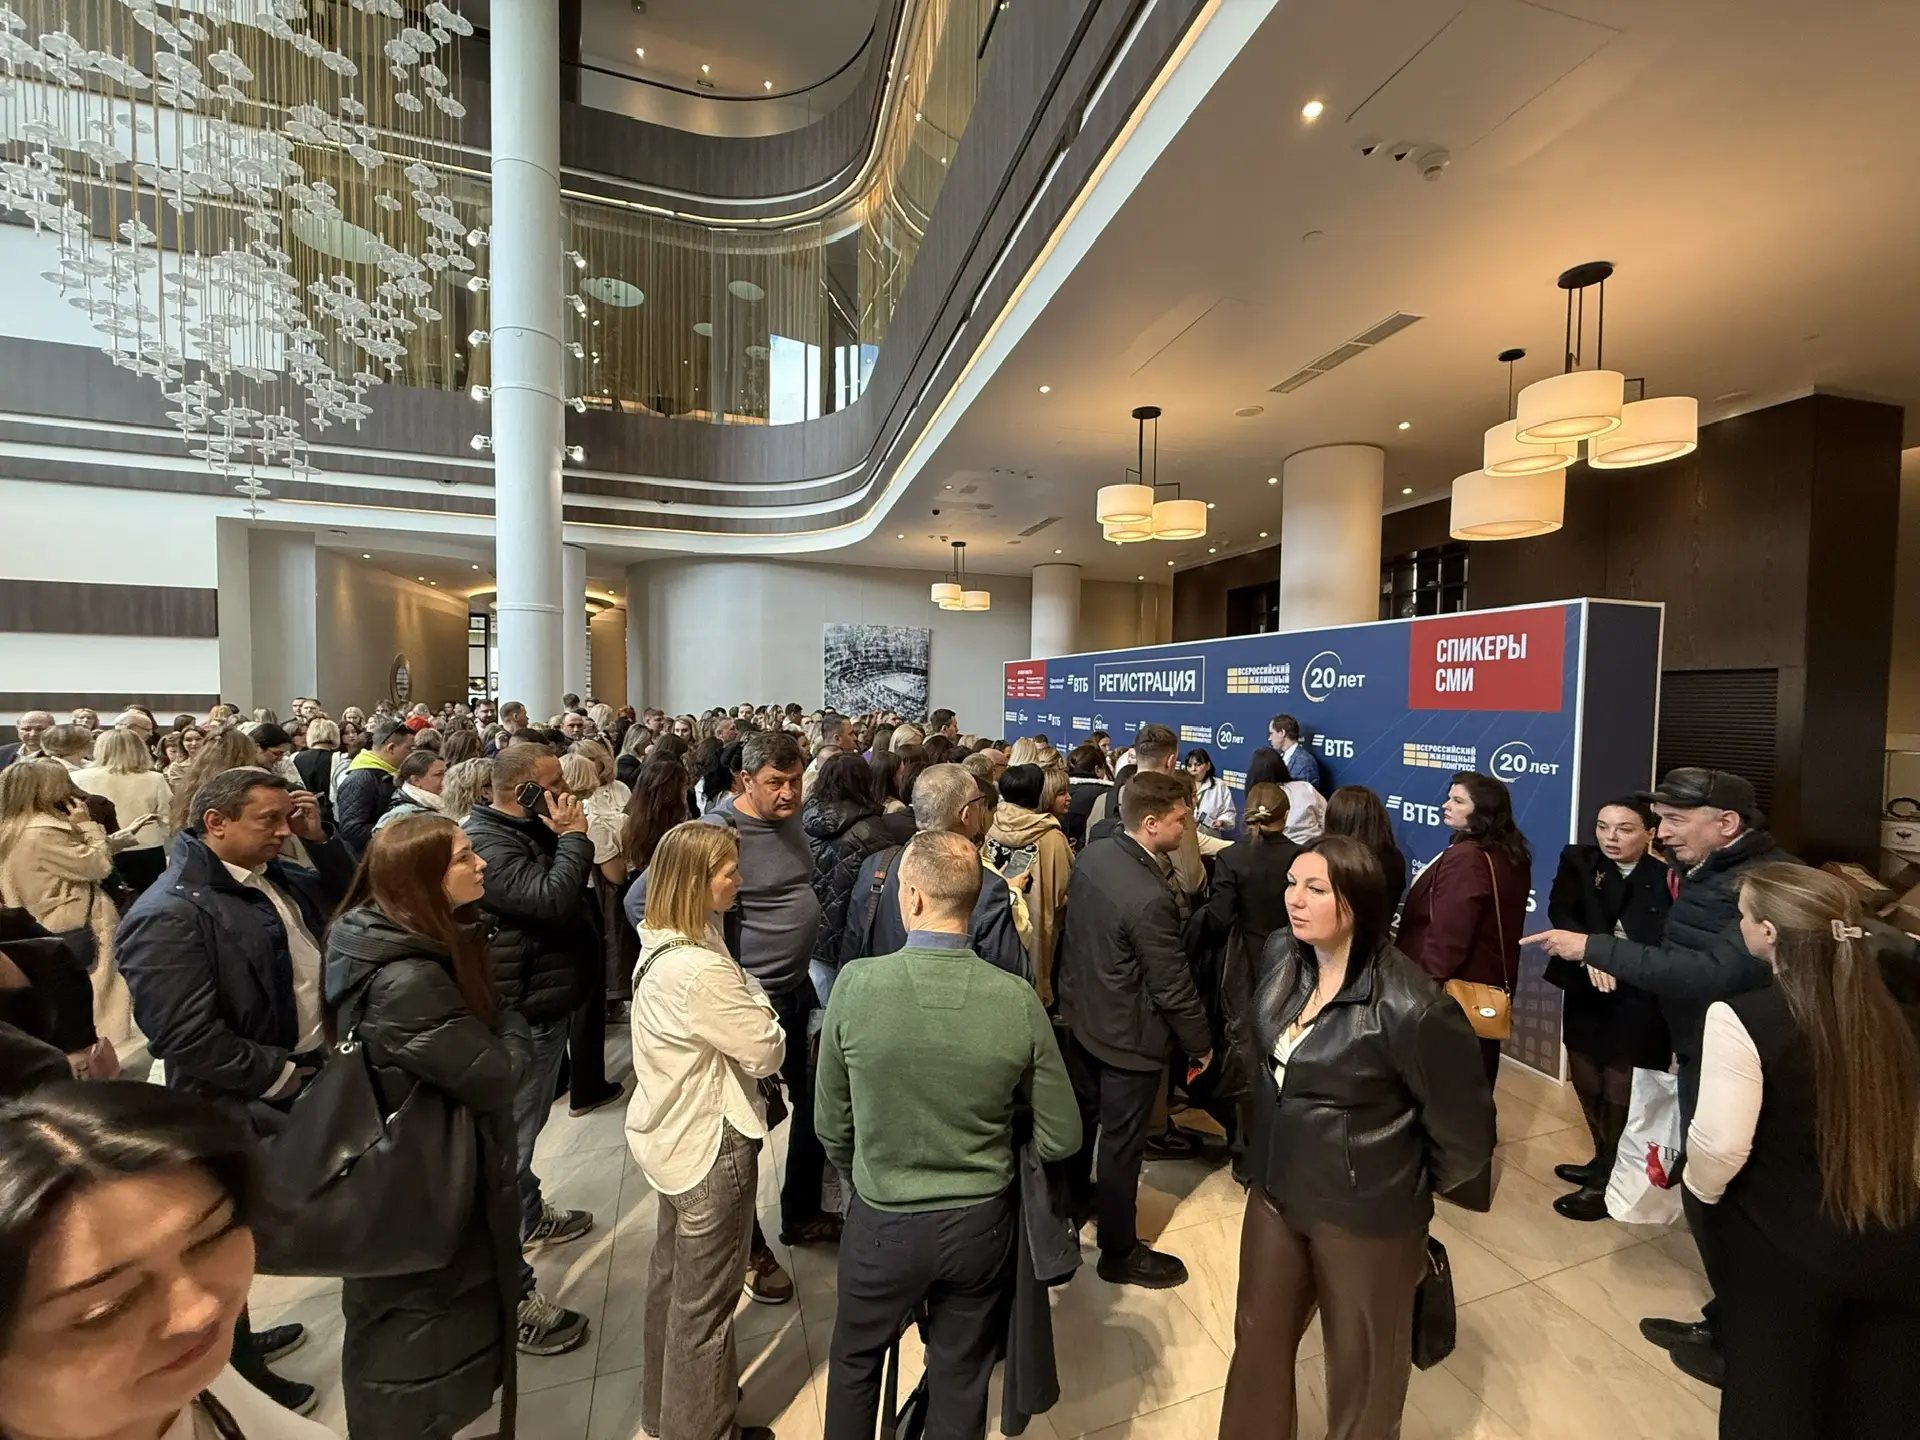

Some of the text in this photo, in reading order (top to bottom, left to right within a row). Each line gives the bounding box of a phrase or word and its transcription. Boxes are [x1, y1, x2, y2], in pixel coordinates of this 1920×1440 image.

[1436, 633, 1528, 663] СПИКЕРЫ
[1238, 663, 1290, 676] ВСЕРОССИЙСКИЙ
[1310, 667, 1365, 688] 20 лет
[1435, 667, 1474, 692] СМИ
[1073, 677, 1089, 693] ВТБ
[1099, 670, 1196, 697] РЕГИСТРАЦИЯ
[1220, 731, 1232, 743] 20
[1325, 738, 1354, 758] ВТБ
[1416, 744, 1476, 755] ВСЕРОССИЙСКИЙ
[1429, 752, 1476, 764] ЖИЛИЩНЫЙ
[1441, 761, 1476, 772] КОНГРЕСС
[1499, 753, 1560, 775] 20 лет
[1402, 801, 1440, 827] ВТБ
